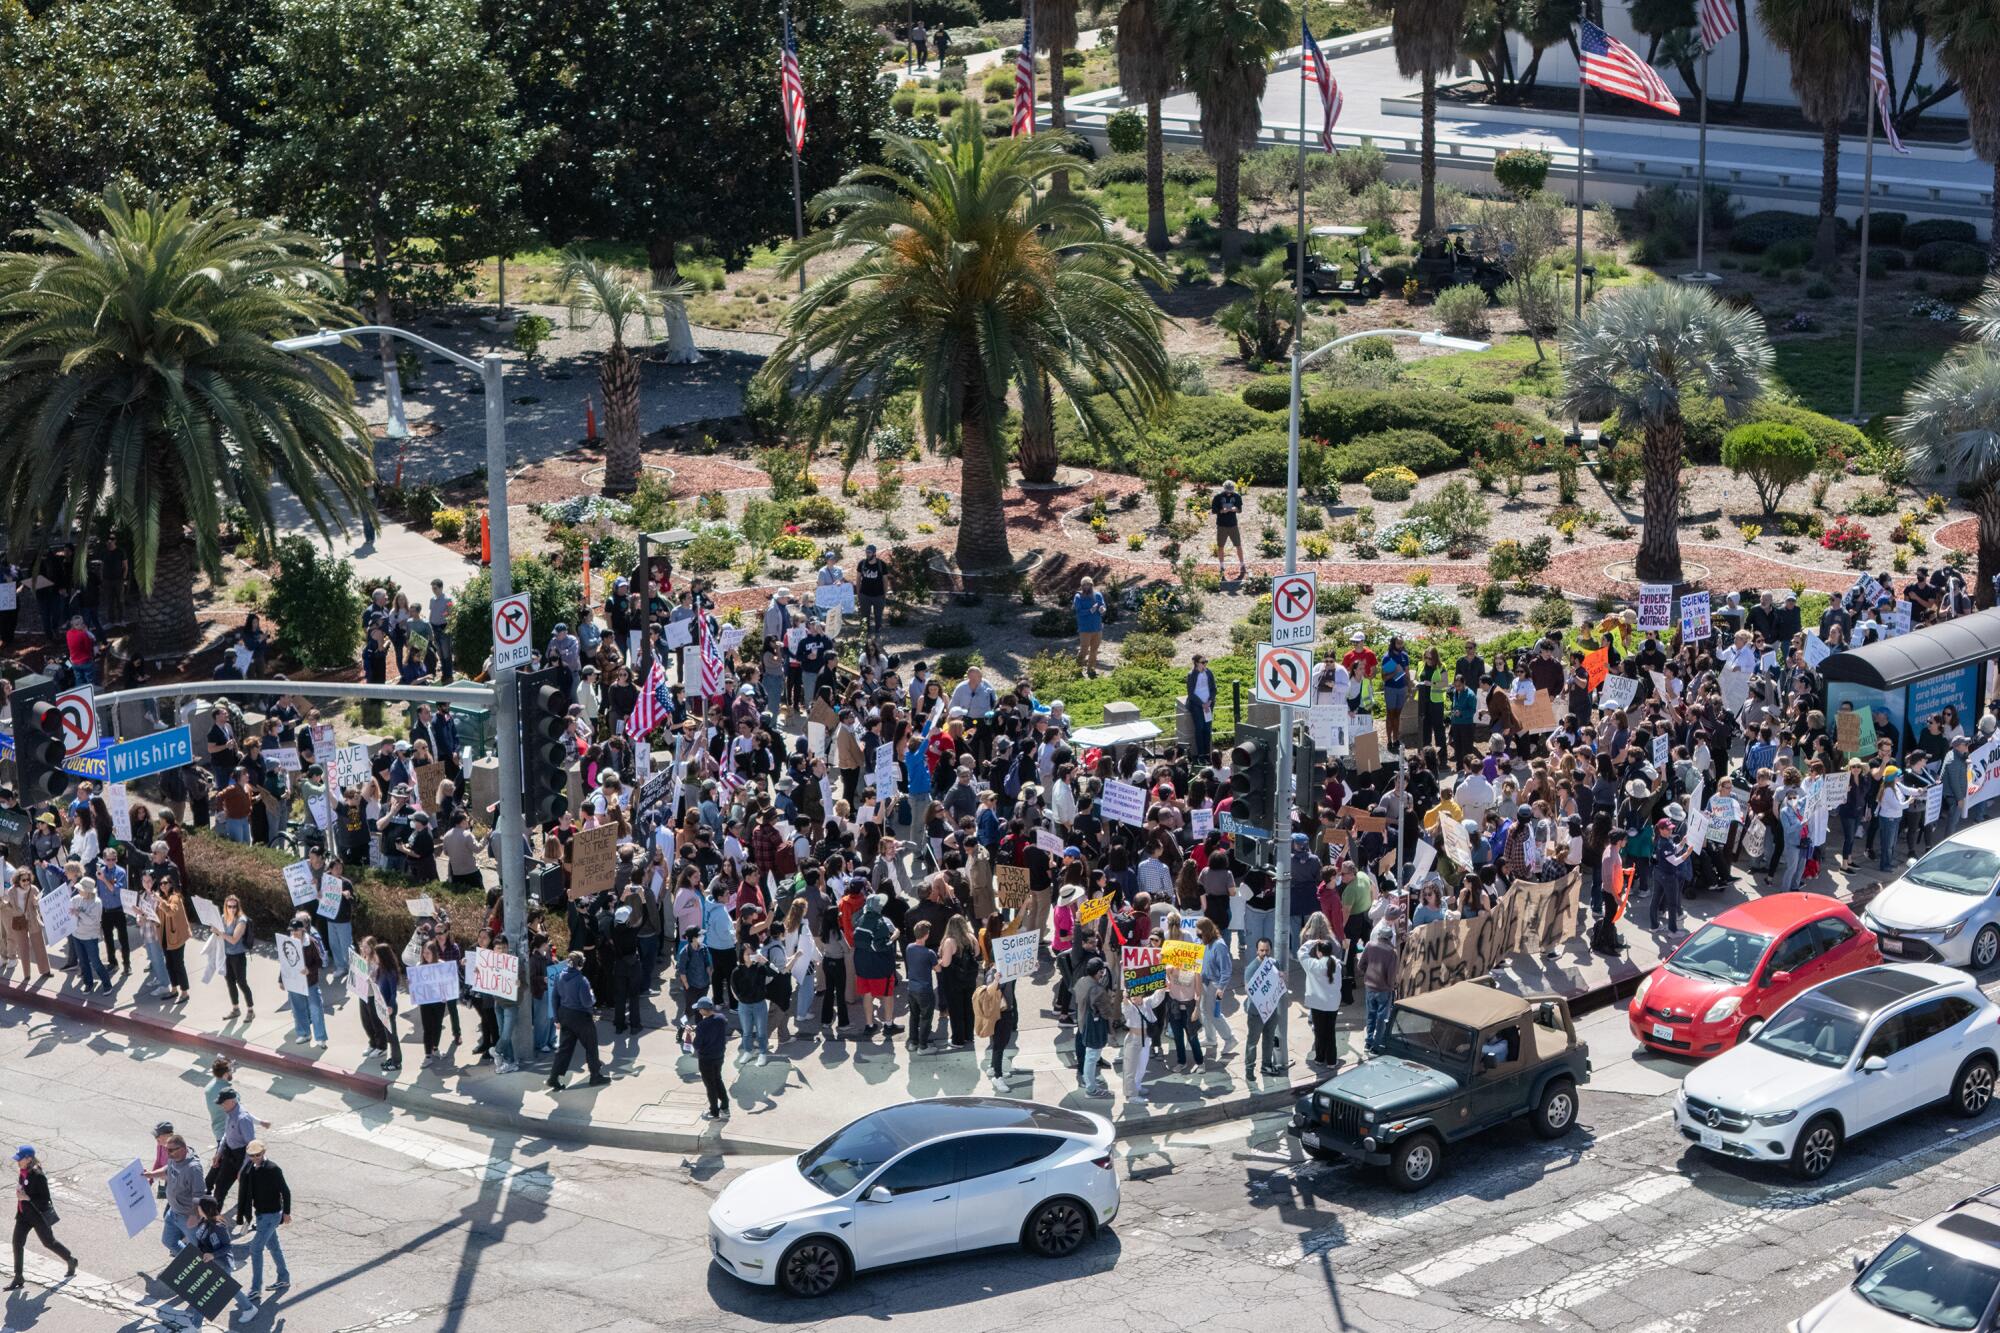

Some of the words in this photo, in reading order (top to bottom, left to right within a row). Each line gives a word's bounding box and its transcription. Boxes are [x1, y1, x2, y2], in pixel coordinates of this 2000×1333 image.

[1640, 594, 1670, 604] EVIDENCE
[1682, 593, 1708, 607] SCIENCE
[1644, 604, 1667, 615] BASED
[1640, 615, 1669, 626] OUTRAGE
[1276, 628, 1289, 640] ON
[1292, 625, 1311, 638] RED
[1694, 625, 1710, 637] REAL
[498, 650, 511, 663] ON
[513, 646, 529, 660] RED
[806, 642, 824, 650] UCLA
[1916, 688, 1930, 700] are
[1931, 681, 1956, 697] hiding
[1915, 699, 1940, 712] inside
[1941, 692, 1965, 705] every
[113, 740, 187, 774] Wilshire
[337, 746, 361, 765] AVE
[62, 757, 106, 776] TUDENTS
[338, 764, 353, 775] UR
[337, 771, 370, 788] CIENCE
[579, 825, 614, 845] SCIENCE
[584, 845, 591, 856] IS
[593, 839, 609, 853] TRUE
[1002, 866, 1023, 876] THEY
[1002, 873, 1024, 882] TOOK
[999, 882, 1012, 892] MY
[1013, 882, 1030, 894] JOB
[44, 891, 63, 905] THINK
[1002, 934, 1036, 951] Science
[480, 949, 517, 974] SCIENCE
[1005, 947, 1032, 963] SAVES
[1172, 948, 1198, 959] SCIENCE
[1007, 957, 1036, 977] LIVES
[1125, 970, 1136, 980] SO
[474, 967, 490, 991] ALL
[502, 976, 513, 996] US
[1248, 960, 1274, 997] DEFIANC
[1129, 985, 1146, 997] ARE
[1146, 980, 1166, 993] HERE
[1261, 980, 1273, 996] FOR
[174, 1255, 202, 1285] SCIENCE
[187, 1268, 213, 1294] TRUMPS
[197, 1276, 226, 1307] SILENCE
